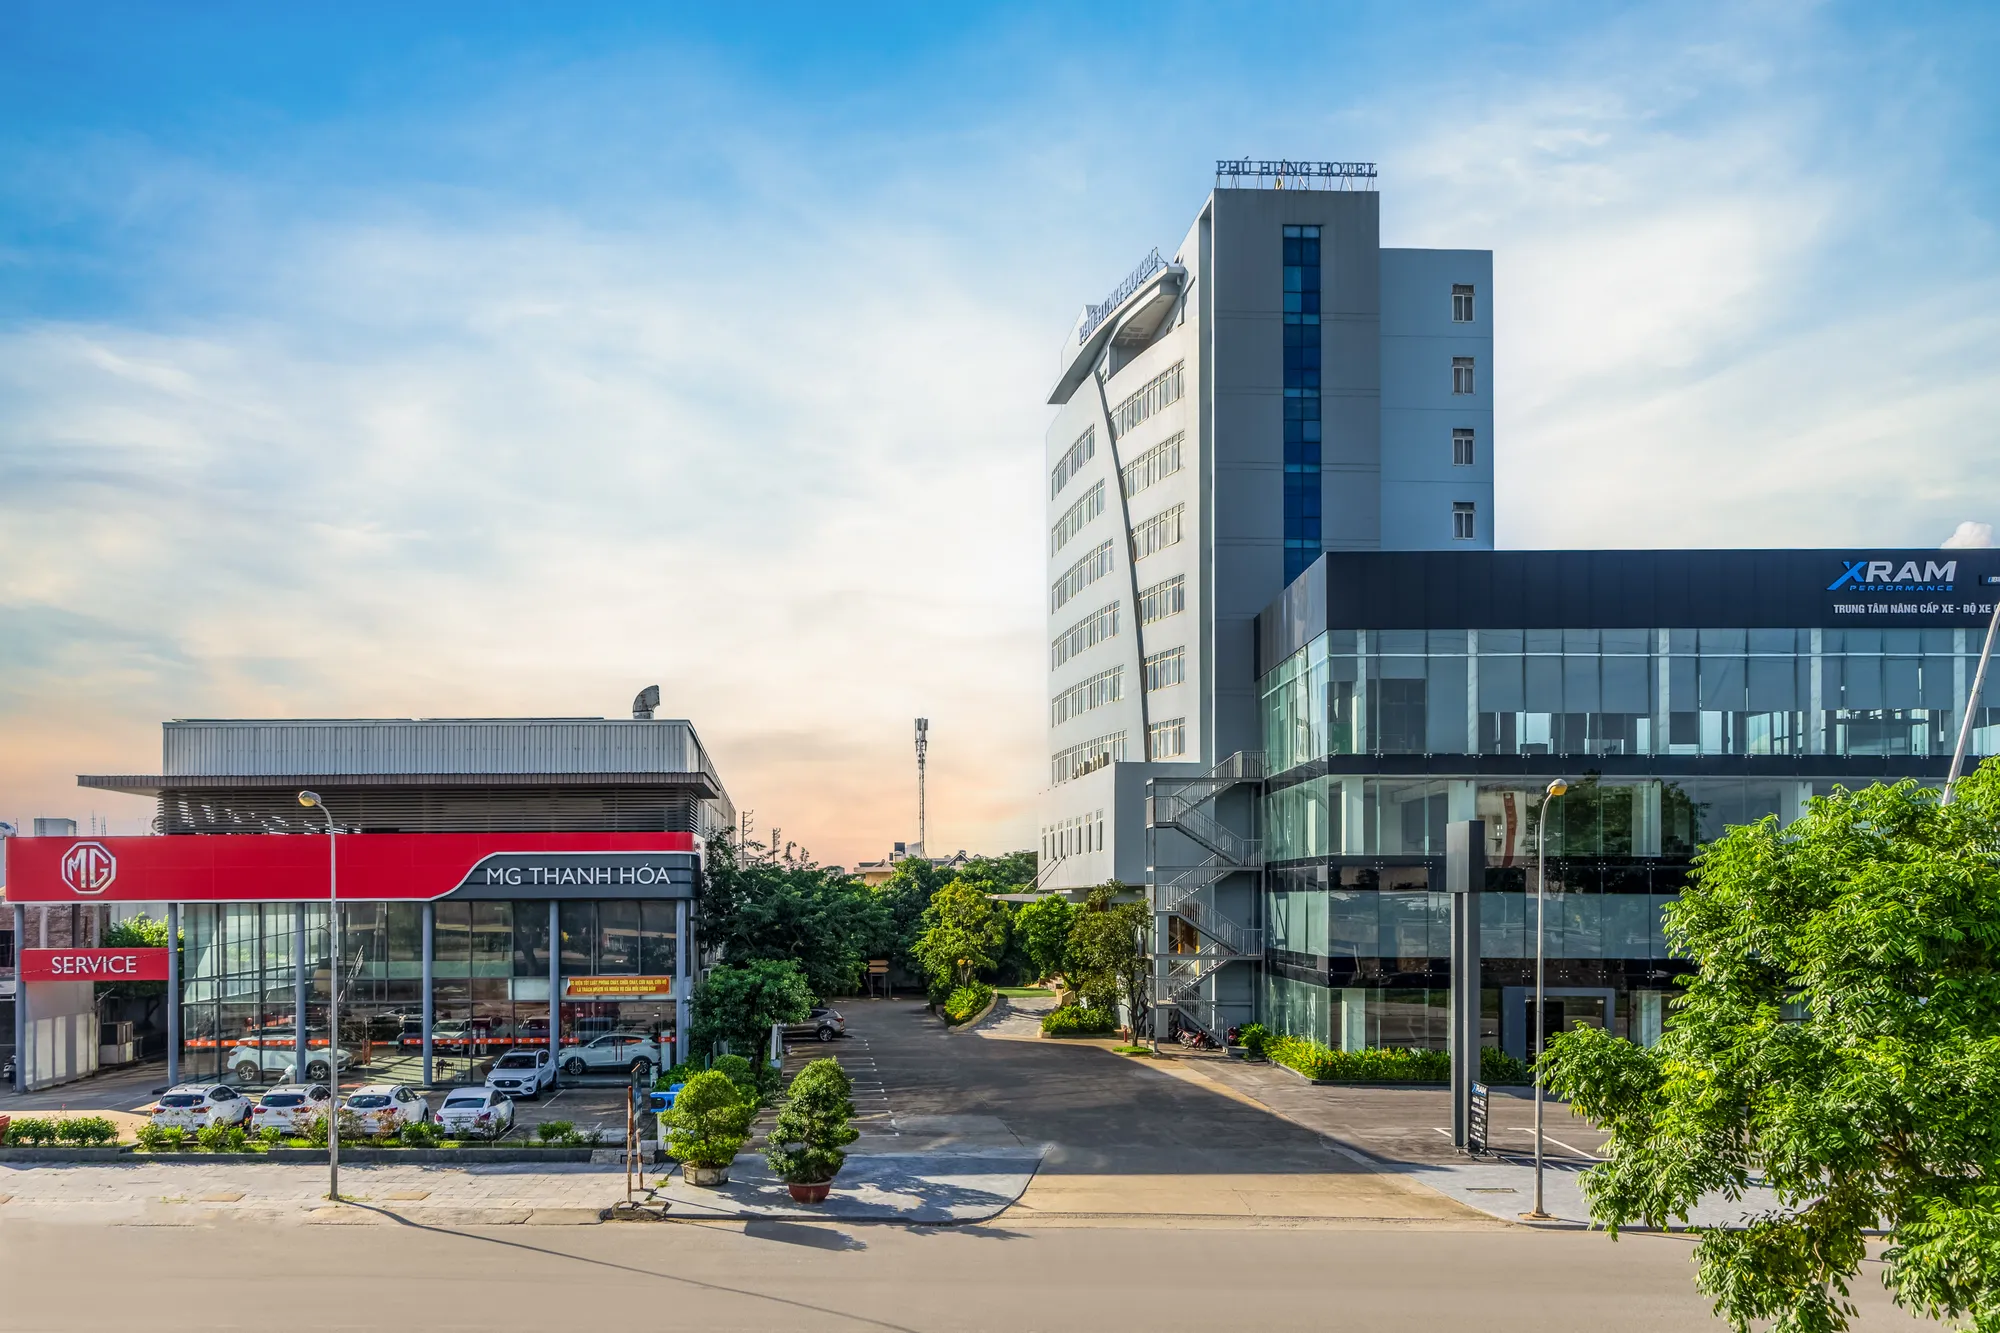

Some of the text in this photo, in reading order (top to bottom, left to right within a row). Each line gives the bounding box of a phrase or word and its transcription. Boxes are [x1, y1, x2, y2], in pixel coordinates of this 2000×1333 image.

[1318, 162, 1378, 177] HOTEL
[1827, 561, 1957, 590] XRAM
[1833, 604, 1865, 614] TRUNG
[1867, 602, 1888, 614] TÂM
[1891, 602, 1918, 614] NÂNG
[1919, 601, 1939, 614] CẤP
[1941, 604, 1954, 614] XE
[1962, 602, 1976, 616] ĐỘ
[1979, 604, 1991, 614] XE
[67, 848, 109, 888] MG
[486, 863, 671, 885] MG THANH HÓA
[51, 956, 137, 974] SERVICE
